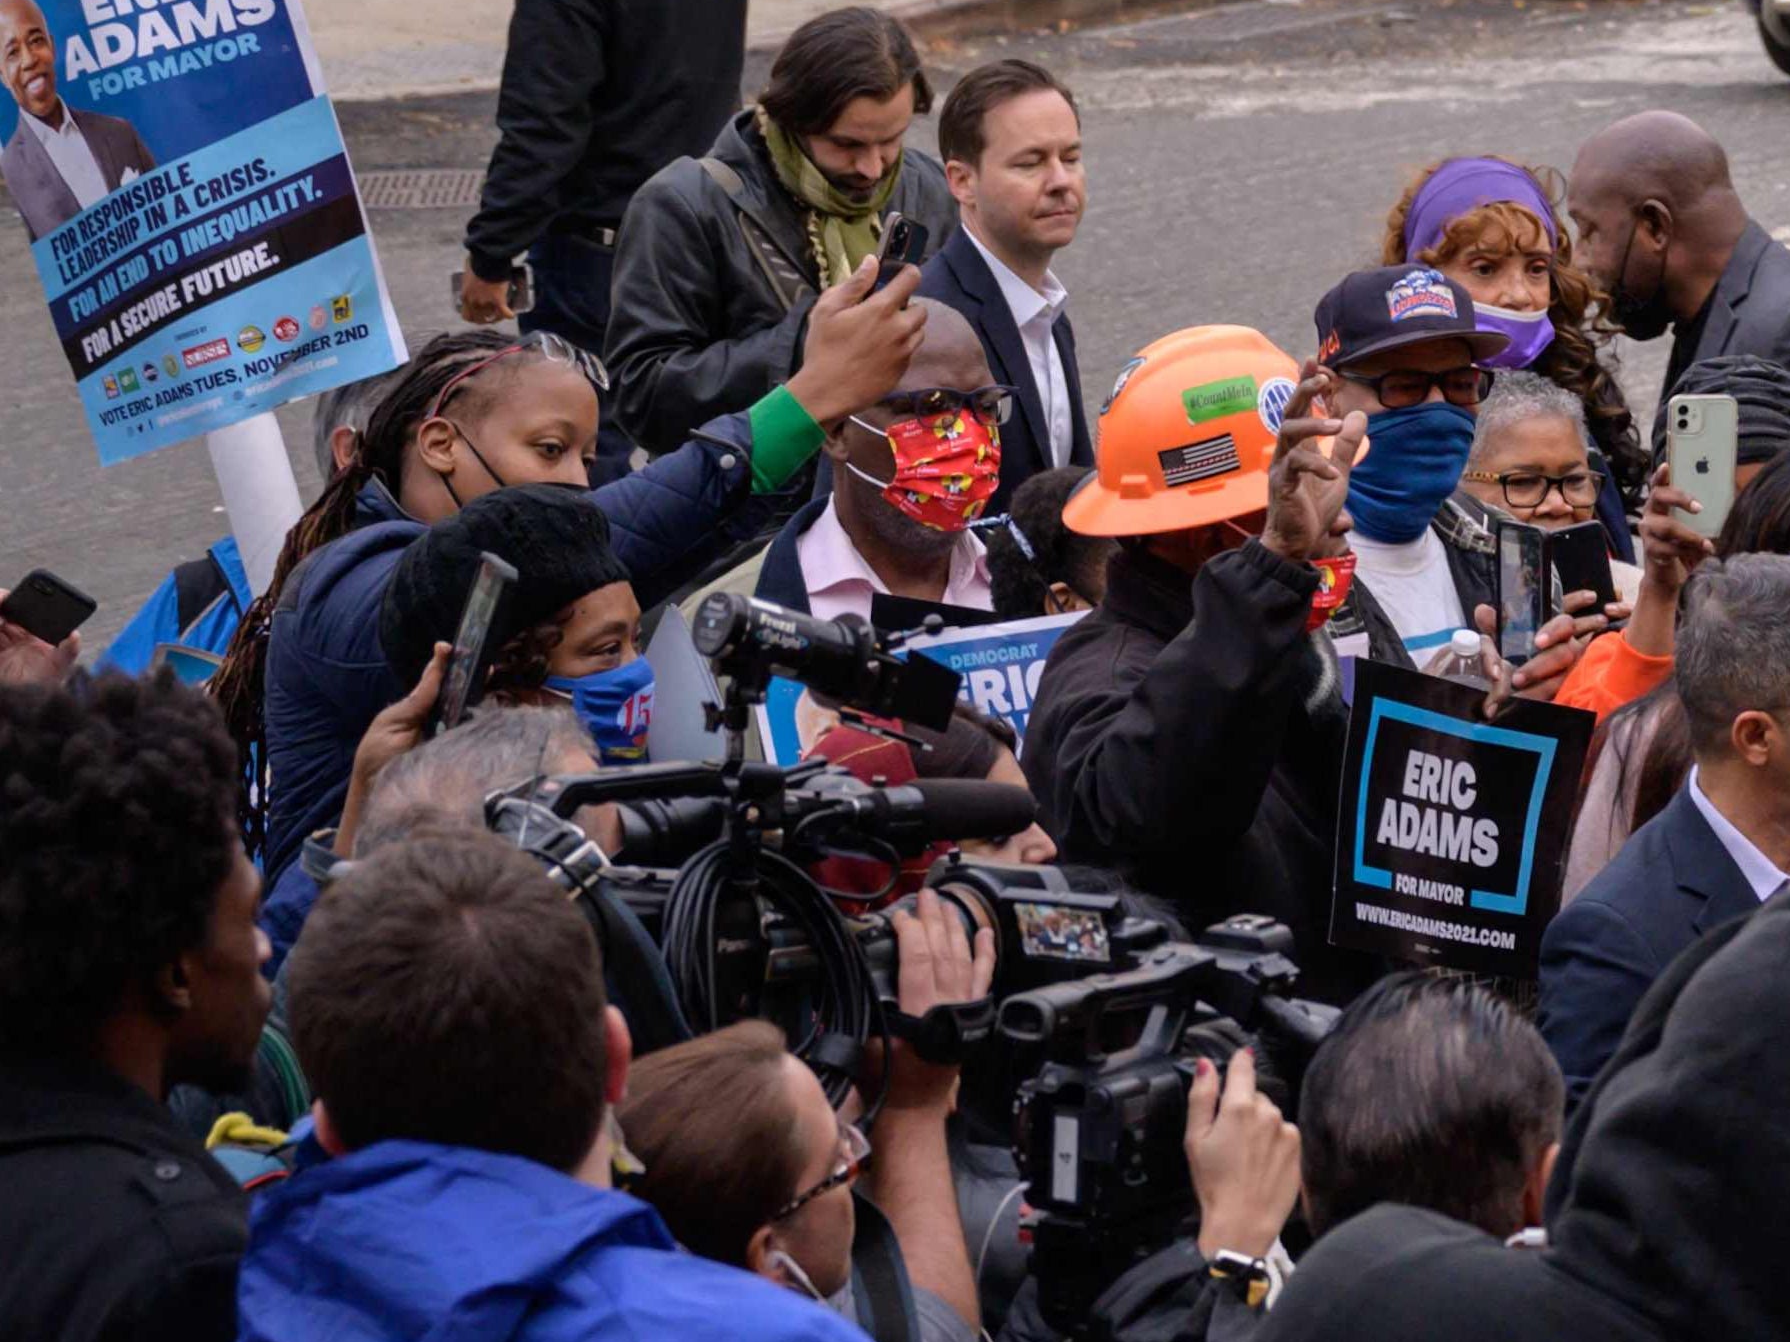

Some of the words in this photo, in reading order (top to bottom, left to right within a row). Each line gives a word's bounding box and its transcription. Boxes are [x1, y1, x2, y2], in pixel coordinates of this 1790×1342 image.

[87, 66, 145, 101] FOR
[146, 32, 261, 86] MAYOR
[50, 228, 77, 261] FOR
[79, 162, 195, 245] RESPONSIBLE
[57, 218, 141, 286] LEADERSHIP
[143, 203, 168, 233] IN
[172, 194, 190, 219] A
[193, 157, 277, 208] CRISIS.
[68, 287, 100, 323] FOR
[99, 273, 120, 306] AN
[116, 253, 150, 291] END
[148, 238, 180, 271] TO
[178, 174, 324, 257] INEQUALITY.
[81, 327, 111, 364] FOR
[109, 319, 125, 347] A
[120, 282, 183, 338] SECURE
[180, 241, 281, 305] FUTURE.
[98, 405, 130, 428] VOTE
[128, 395, 155, 418] ERIC
[154, 381, 196, 410] ADAMS
[193, 367, 243, 396] TUES,
[243, 339, 332, 378] NOVEMBER
[334, 323, 370, 346] 2ND
[950, 642, 1039, 670] DEMOCRAT
[1402, 748, 1477, 810] ERIC
[1376, 797, 1499, 867] ADAMS
[1395, 872, 1417, 897] FOR
[1418, 877, 1464, 905] MAYOR
[1355, 901, 1515, 949] WWW.ERICADAMS2021.COM
